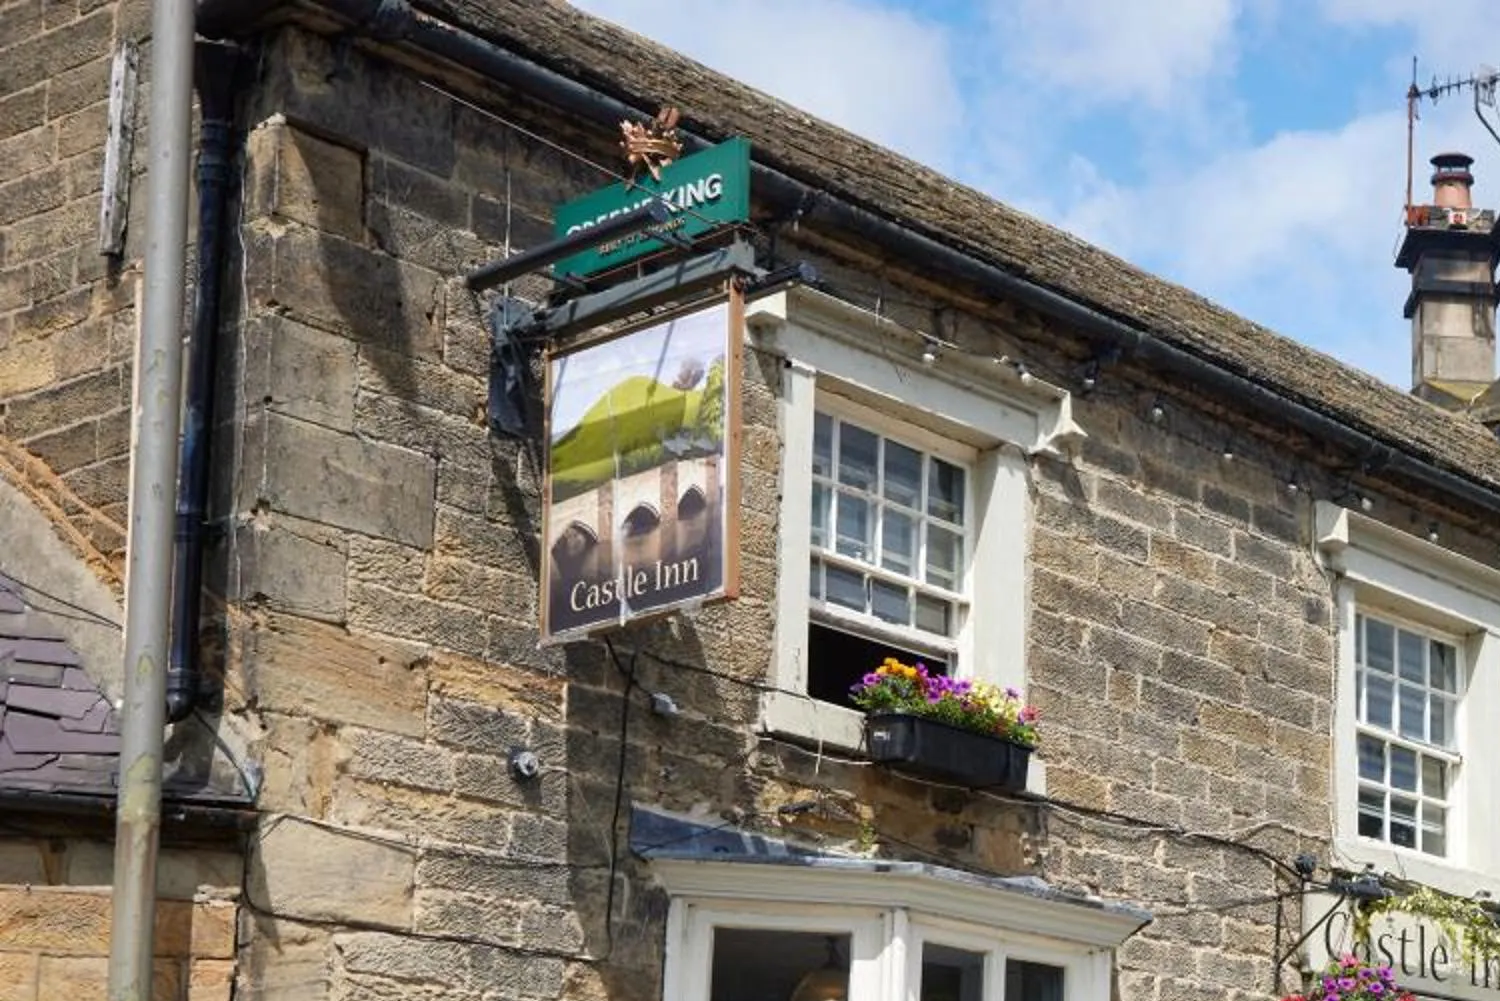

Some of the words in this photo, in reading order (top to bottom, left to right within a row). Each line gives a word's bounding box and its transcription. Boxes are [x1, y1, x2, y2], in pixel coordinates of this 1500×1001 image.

[661, 173, 723, 212] KING
[571, 564, 647, 611] Castle
[655, 557, 699, 590] Inn
